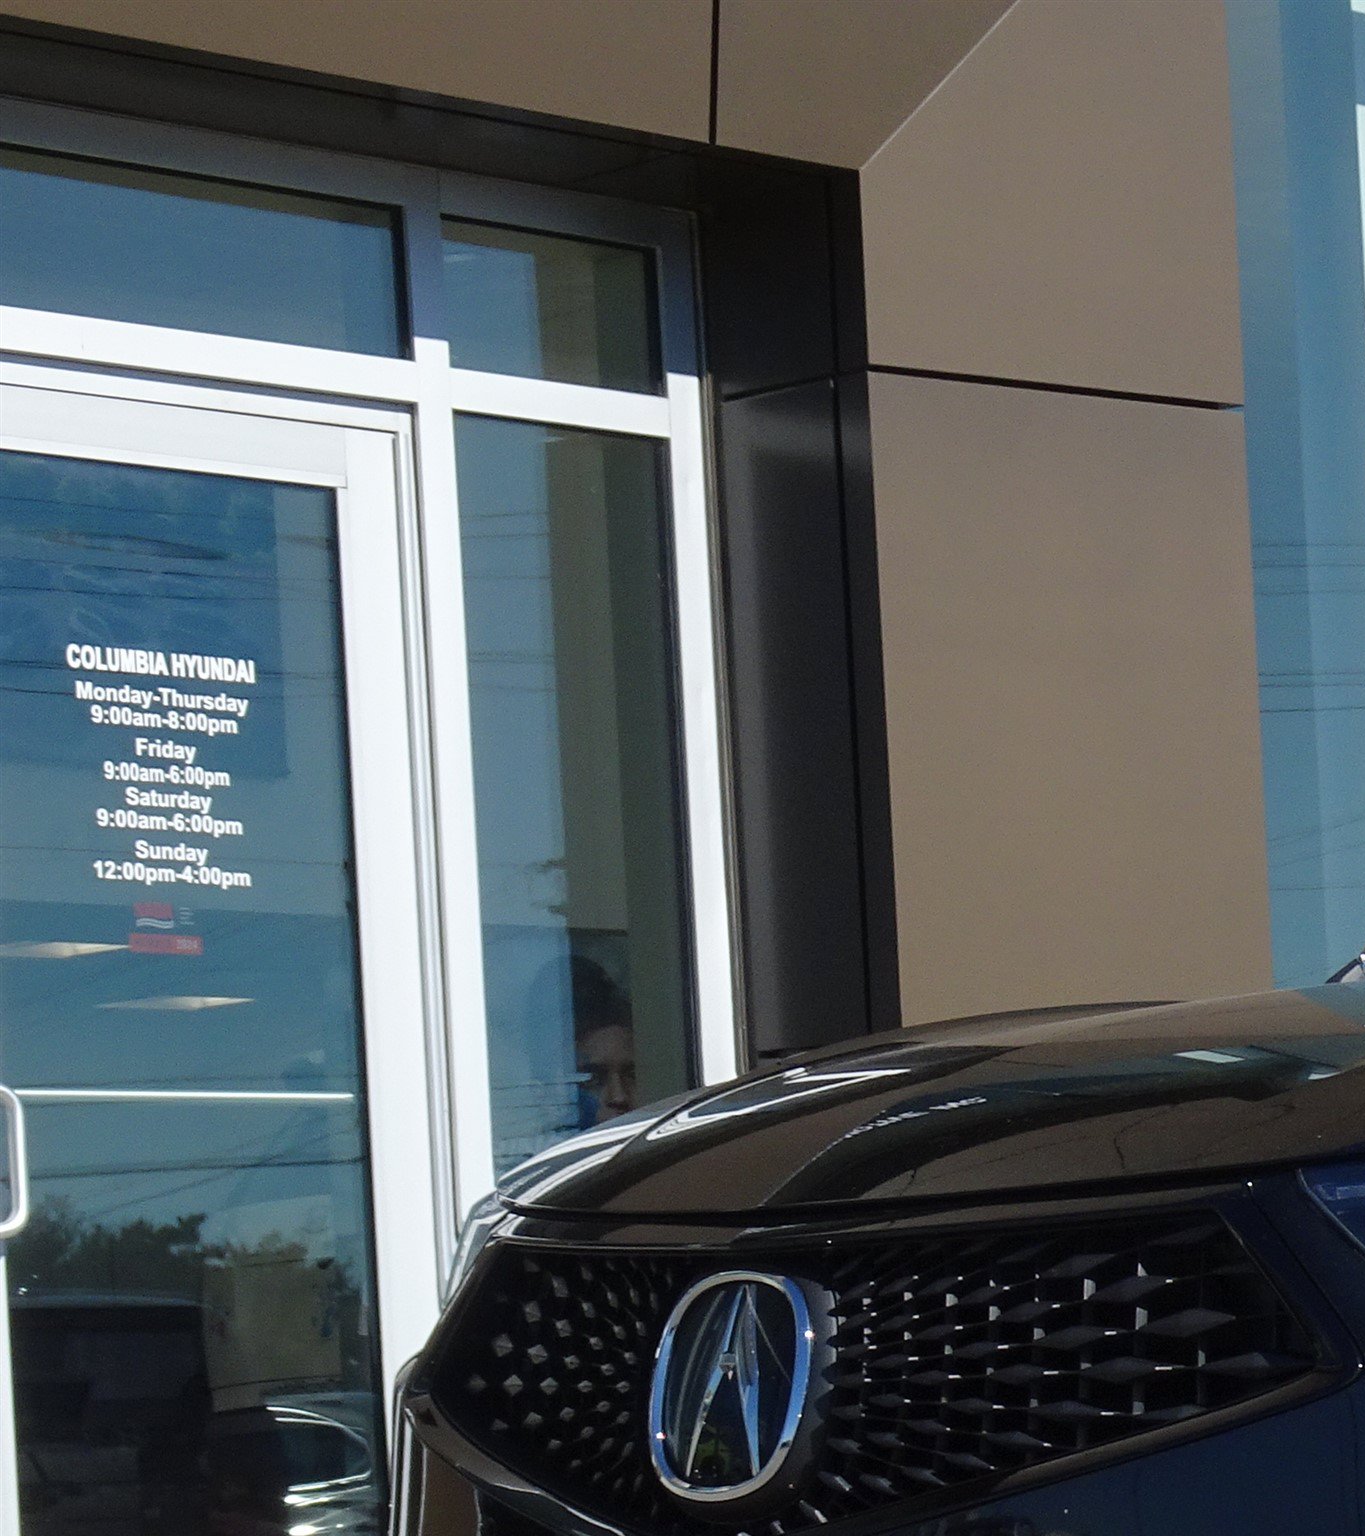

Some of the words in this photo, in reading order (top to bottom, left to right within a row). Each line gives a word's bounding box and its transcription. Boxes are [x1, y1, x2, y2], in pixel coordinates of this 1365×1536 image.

[66, 643, 169, 676] COLUMBIA
[170, 653, 256, 684] HYUNDAI
[75, 680, 249, 717] Monday-Thursday
[90, 704, 238, 737] 9:00am-8:00pm
[135, 737, 197, 765] Friday
[103, 760, 231, 788] 9:00am-6:00pm
[125, 786, 212, 815] Saturday
[95, 807, 243, 838] 9:00am-6:00pm
[134, 839, 209, 867] Sunday
[93, 860, 252, 890] 12:00pm-4:00pm
